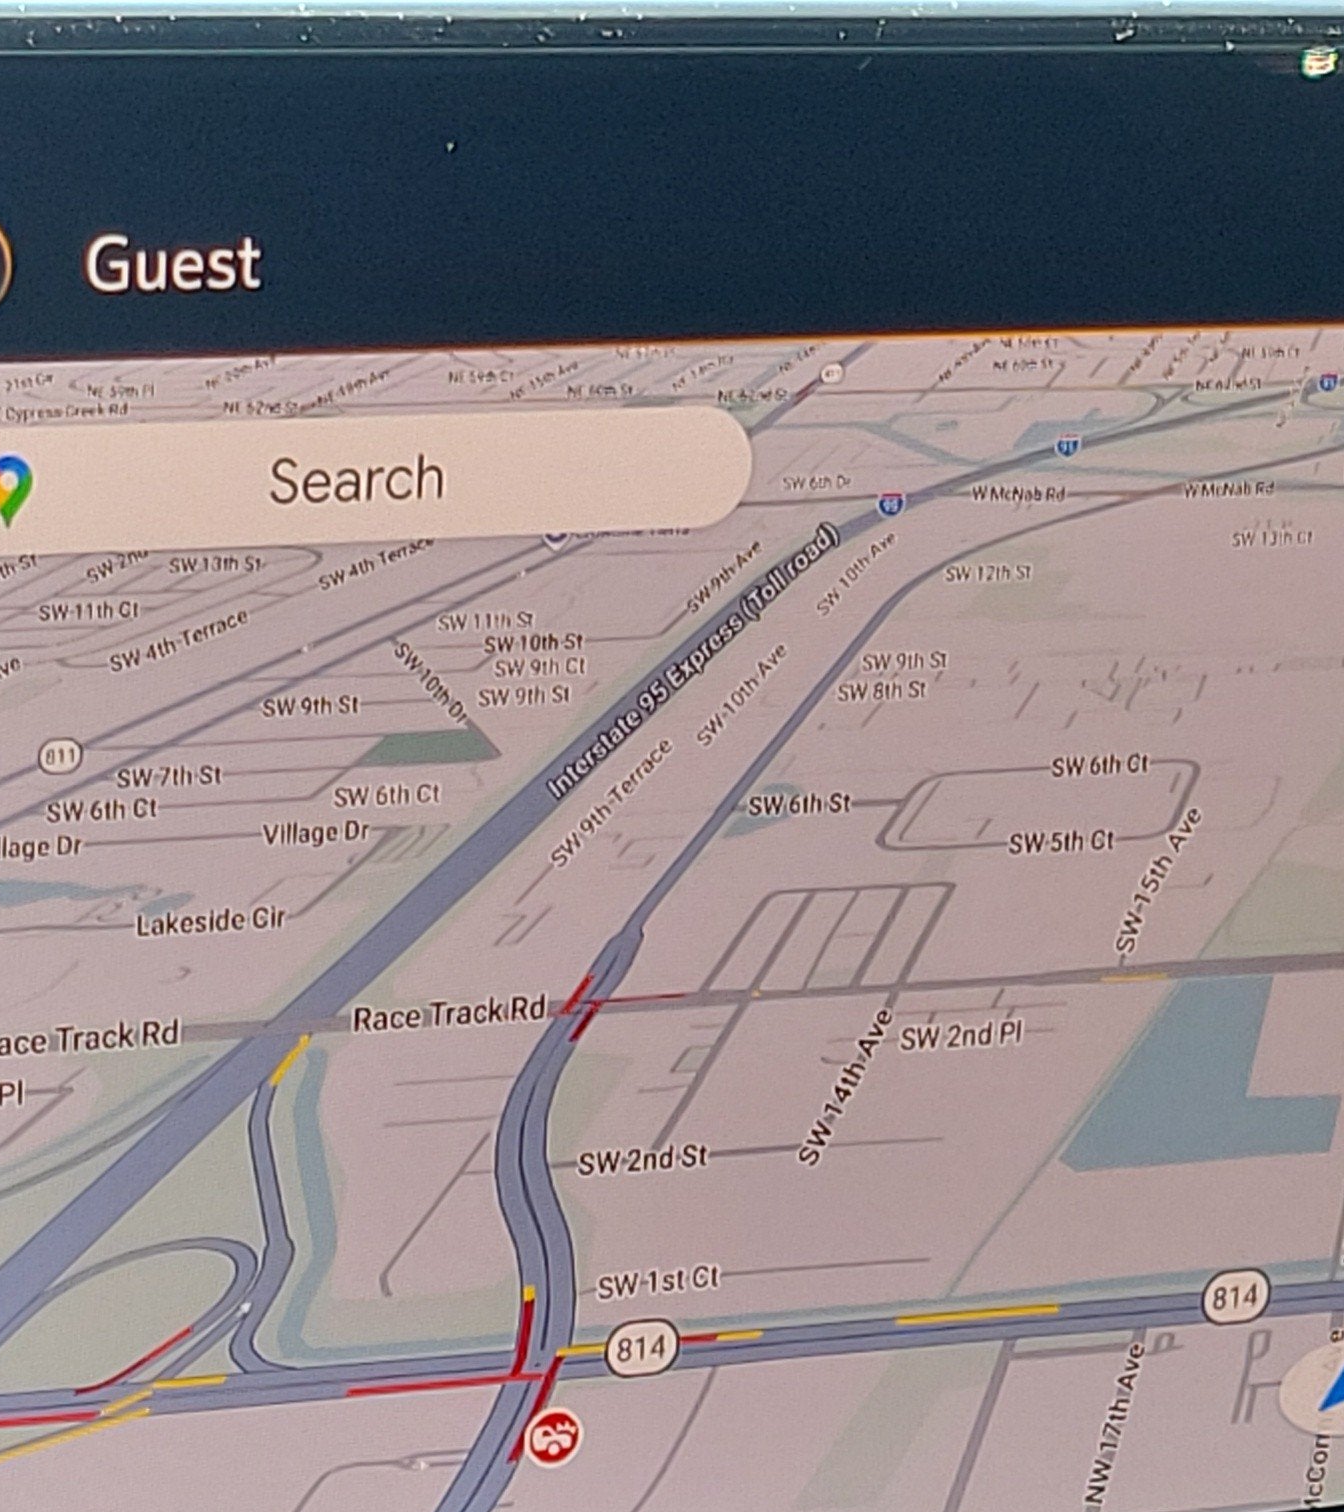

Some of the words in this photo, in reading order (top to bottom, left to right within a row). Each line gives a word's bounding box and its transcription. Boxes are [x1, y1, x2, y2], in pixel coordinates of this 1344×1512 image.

[86, 233, 261, 293] Guest
[270, 453, 444, 505] Search
[1046, 486, 1066, 501] Rd
[19, 555, 37, 571] St
[945, 566, 972, 582] SW
[978, 565, 1010, 581] 12th
[1016, 564, 1031, 579] St
[39, 604, 68, 621] SW
[76, 602, 113, 619] 11th
[119, 601, 139, 618] Ct
[111, 650, 140, 672] SW
[146, 638, 176, 660] 4th
[180, 610, 249, 647] Terrace
[484, 637, 514, 653] SW
[521, 635, 558, 652] 10th
[564, 634, 583, 650] St
[547, 708, 642, 800] Interstate
[638, 681, 669, 713] 95
[663, 614, 744, 691] Express
[740, 569, 787, 623] (Toll
[783, 522, 841, 582] road)
[862, 654, 892, 671] SW
[897, 653, 924, 670] 9th
[930, 652, 946, 668] St
[395, 643, 418, 671] SW
[419, 666, 451, 706] 10th
[447, 703, 467, 724] Dr
[479, 689, 509, 706] SW
[516, 687, 545, 704] 9th
[552, 685, 570, 702] St
[697, 711, 725, 746] SW
[725, 676, 760, 712] 10th
[760, 643, 787, 678] Ave
[837, 684, 867, 702] SW
[874, 683, 902, 699] 8th
[909, 682, 926, 698] St
[263, 699, 294, 718] SW
[301, 697, 332, 715] 9th
[339, 695, 358, 713] St
[117, 769, 152, 788] SW
[159, 766, 192, 786] 7th
[200, 765, 221, 784] St
[1051, 758, 1086, 777] SW
[1090, 756, 1122, 775] 6th
[1126, 754, 1148, 773] Ct
[334, 788, 369, 807] SW
[376, 786, 409, 805] 6th
[417, 784, 440, 803] Ct
[551, 831, 582, 868] SW
[580, 802, 612, 835] 9th
[610, 738, 673, 804] Terrace
[748, 796, 782, 816] SW
[789, 795, 822, 814] 6th
[829, 793, 850, 813] St
[47, 803, 83, 823] SW
[90, 799, 125, 820] 6th
[133, 798, 157, 818] Ct
[57, 836, 82, 856] Dr
[262, 823, 338, 846] Village
[345, 820, 370, 841] Dr
[1008, 834, 1043, 854] SW
[1050, 832, 1083, 852] 5th
[1092, 831, 1114, 850] Ct
[1115, 911, 1143, 952] SW
[1135, 854, 1172, 905] 15th
[1170, 807, 1201, 854] Ave
[136, 909, 245, 937] Lakeside
[252, 907, 286, 929] Cir
[354, 1007, 421, 1032] Race
[428, 999, 503, 1026] Track
[510, 995, 545, 1020] Rd
[55, 1023, 133, 1052] Track
[142, 1019, 179, 1046] Rd
[901, 1027, 939, 1050] SW
[947, 1022, 991, 1048] 2nd
[999, 1019, 1023, 1043] Pl
[799, 1120, 830, 1167] SW
[824, 1061, 864, 1116] 14th
[858, 1009, 893, 1059] Ave
[578, 1151, 619, 1176] SW
[628, 1146, 673, 1172] 2nd
[681, 1144, 708, 1168] St
[598, 1275, 639, 1299] SW
[650, 1269, 684, 1293] 1st
[693, 1265, 719, 1289] Ct
[1212, 1284, 1258, 1311] 814
[616, 1334, 667, 1362] 814
[1118, 1343, 1146, 1392] Ave
[1099, 1399, 1130, 1450] 17th
[1085, 1459, 1114, 1505] NW
